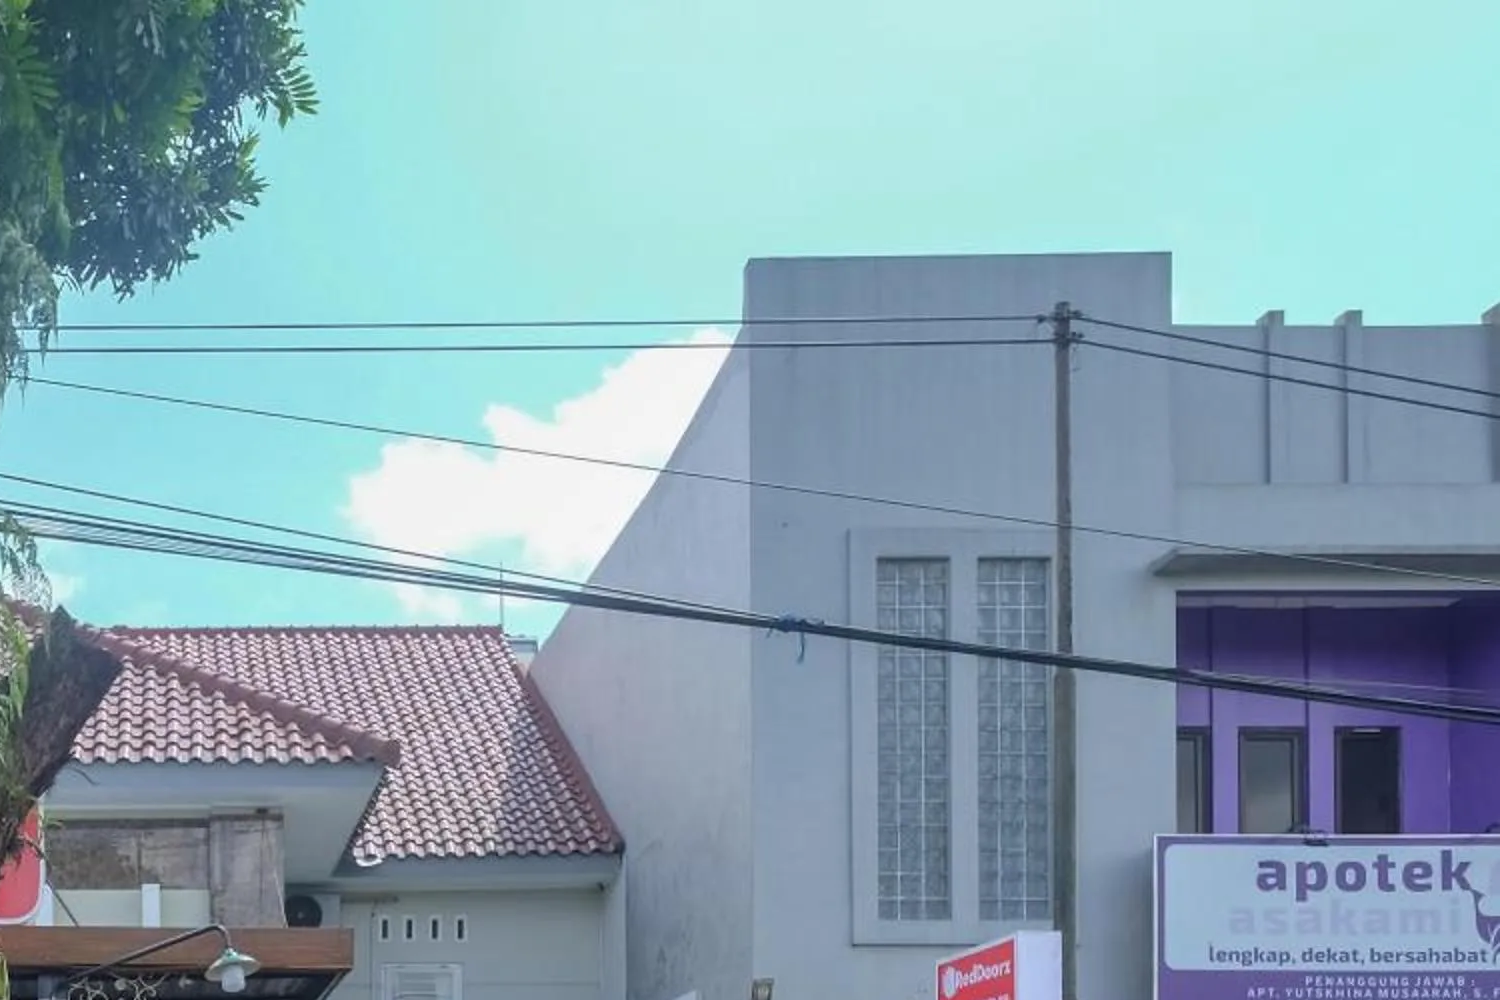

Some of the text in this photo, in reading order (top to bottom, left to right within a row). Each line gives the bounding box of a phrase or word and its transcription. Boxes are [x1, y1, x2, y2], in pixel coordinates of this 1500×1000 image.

[1255, 849, 1473, 902] apotek
[1227, 896, 1463, 937] asakami
[1208, 943, 1489, 967] lengkap, dekat, bersahabat
